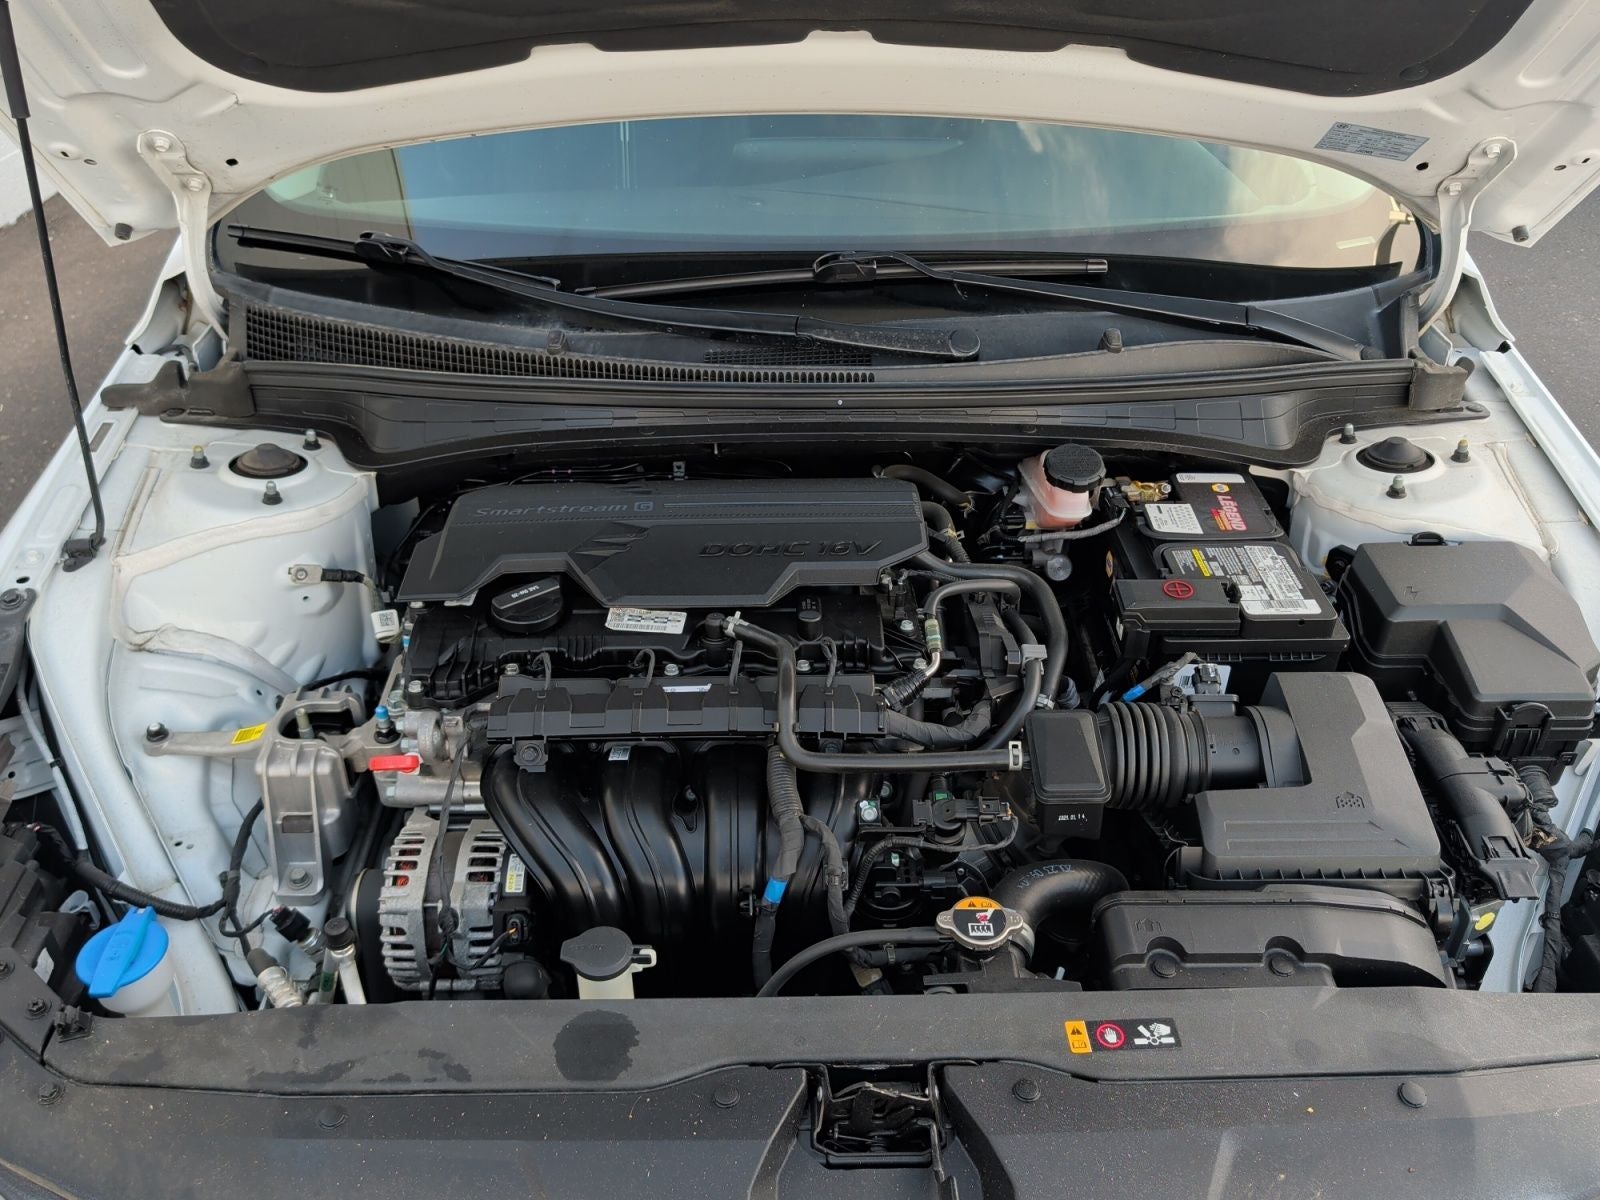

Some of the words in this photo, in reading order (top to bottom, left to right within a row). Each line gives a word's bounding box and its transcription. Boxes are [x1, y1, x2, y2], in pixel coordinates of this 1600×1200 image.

[475, 504, 628, 517] Smartstream
[1217, 495, 1247, 530] LEGEND
[699, 541, 810, 557] DOHC
[817, 540, 882, 556] 16V
